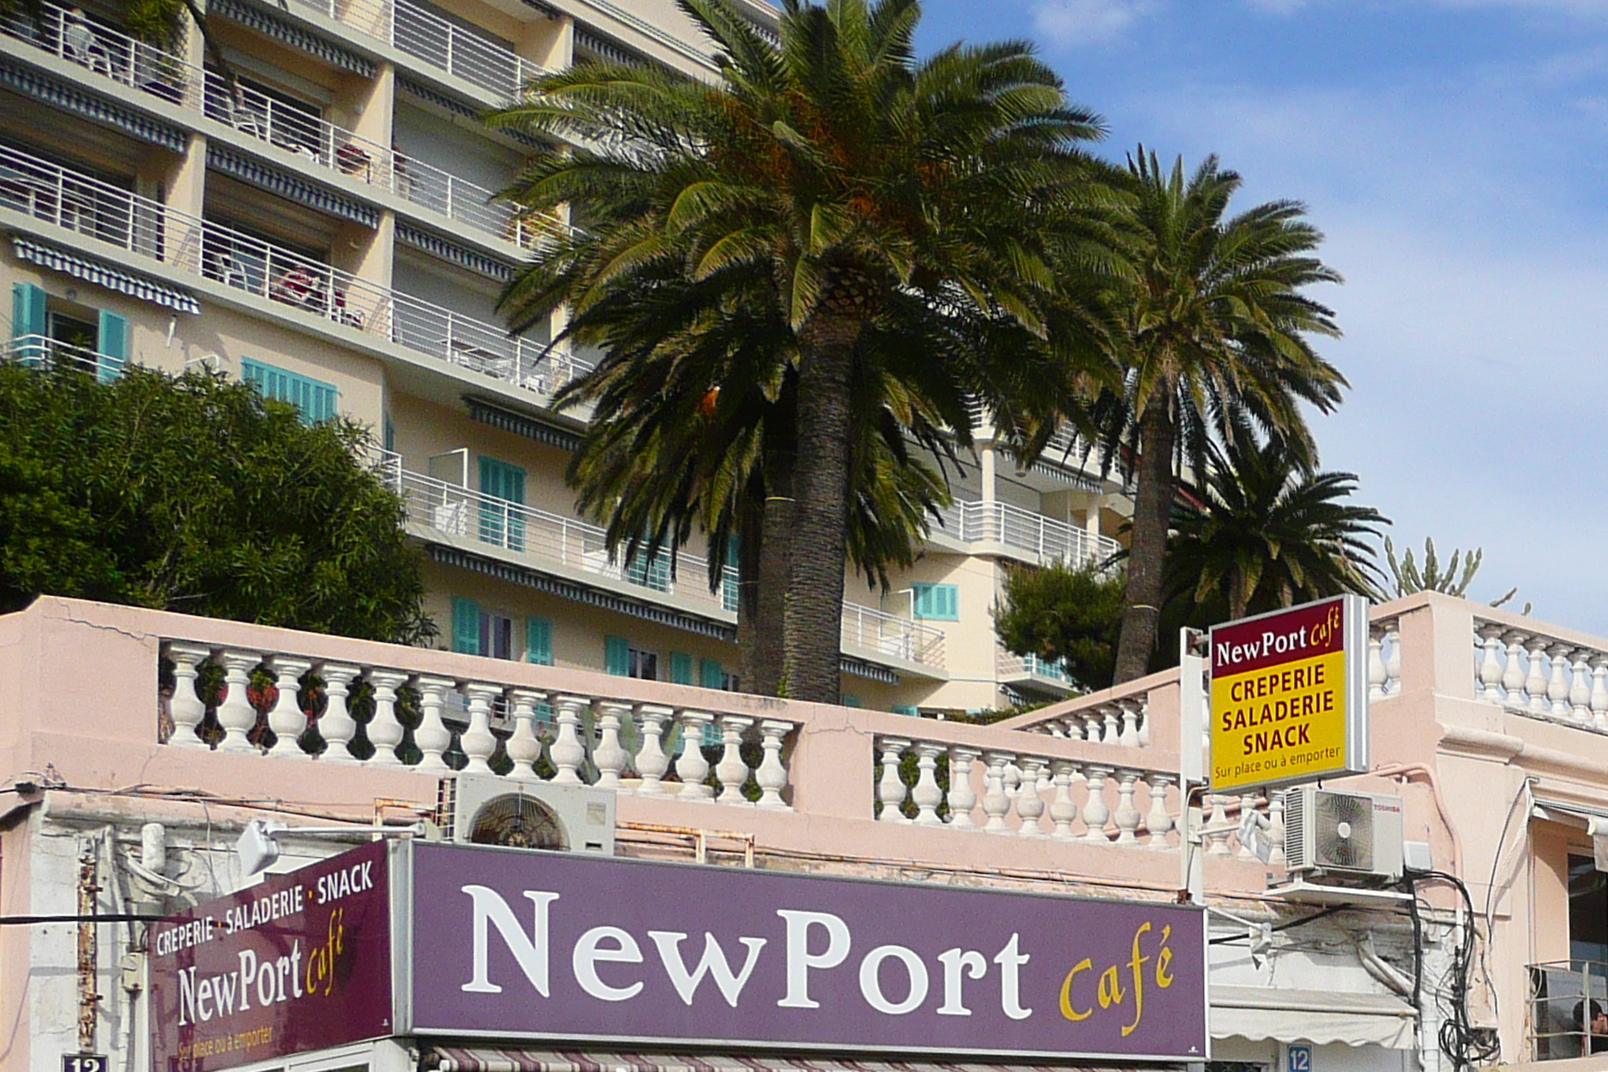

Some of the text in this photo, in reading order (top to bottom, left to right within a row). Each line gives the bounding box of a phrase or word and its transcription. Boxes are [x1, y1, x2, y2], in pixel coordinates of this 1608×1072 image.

[1217, 625, 1307, 667] NewPort
[1231, 663, 1325, 703] CREPERIE
[1222, 690, 1334, 732] SALADERIE
[1243, 723, 1311, 756] SNACK
[1215, 746, 1341, 779] Sur place ou à emporter
[157, 860, 373, 956] CREPERIE SALADERIE SNACK
[461, 884, 1032, 1020] NewPort
[178, 938, 303, 1026] NewPort
[1290, 1050, 1309, 1071] 12
